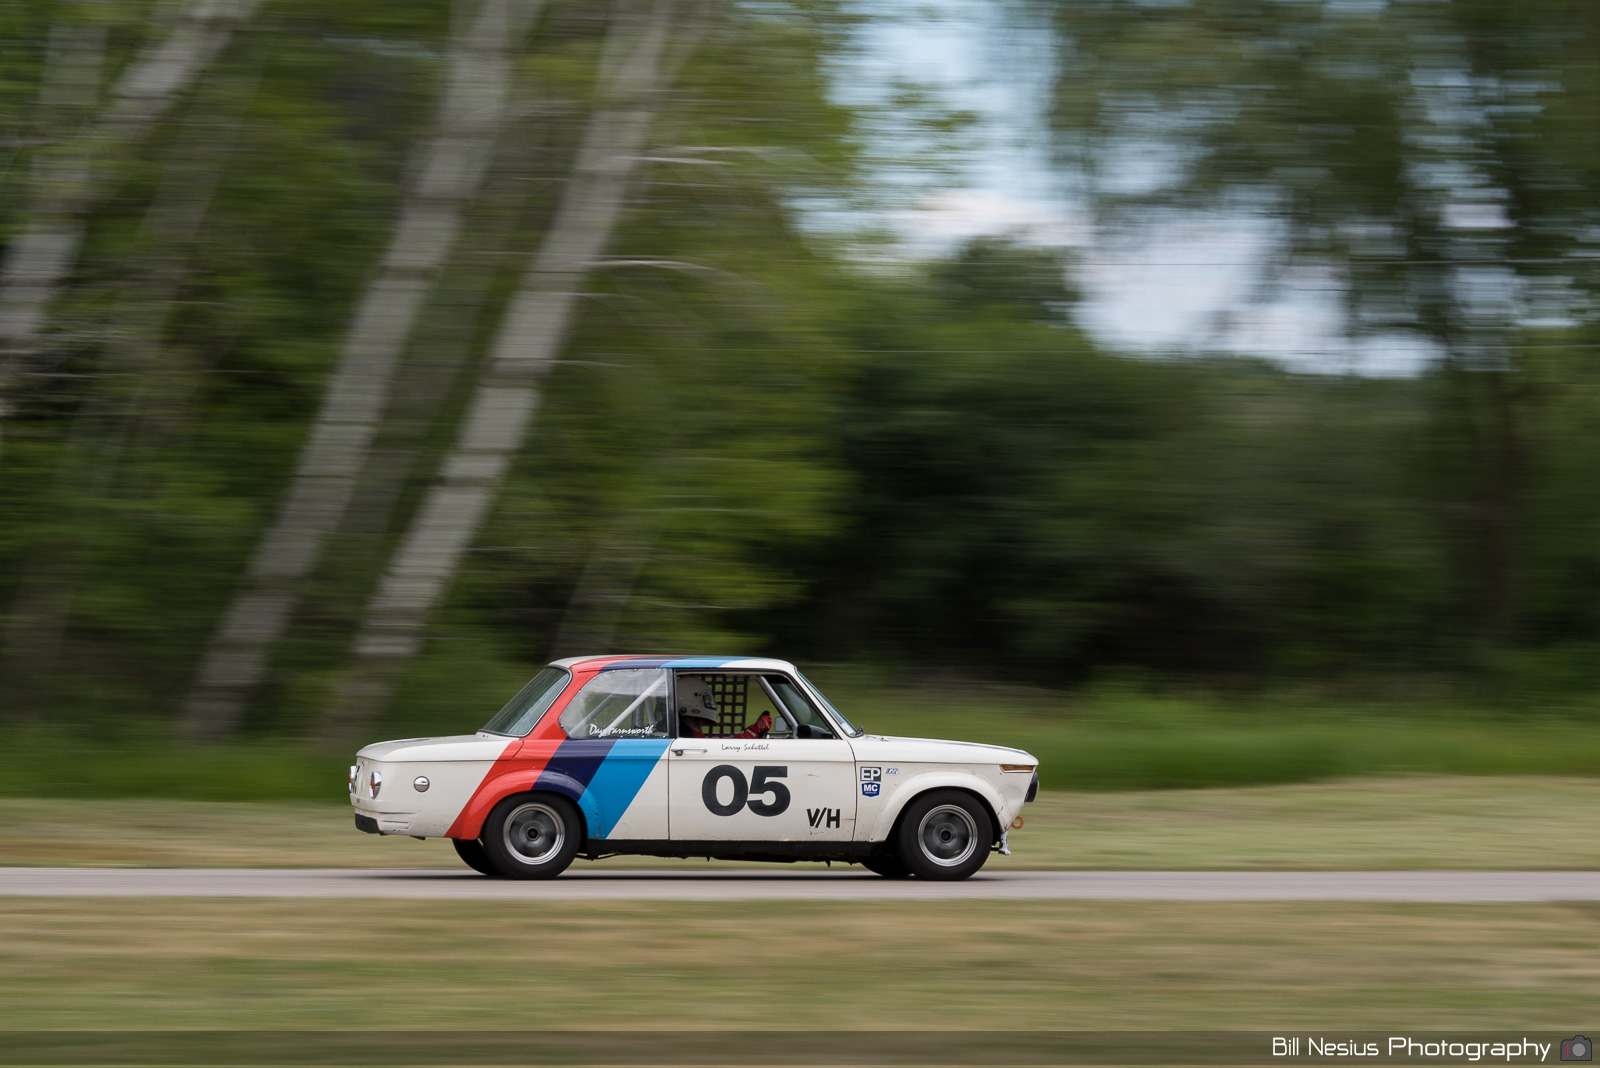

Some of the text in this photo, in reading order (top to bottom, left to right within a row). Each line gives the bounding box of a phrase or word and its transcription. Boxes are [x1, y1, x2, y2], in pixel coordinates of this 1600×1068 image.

[721, 743, 741, 753] Larry
[861, 767, 881, 781] EP
[701, 764, 791, 817] 05
[863, 784, 878, 792] MC
[806, 806, 841, 829] V/H
